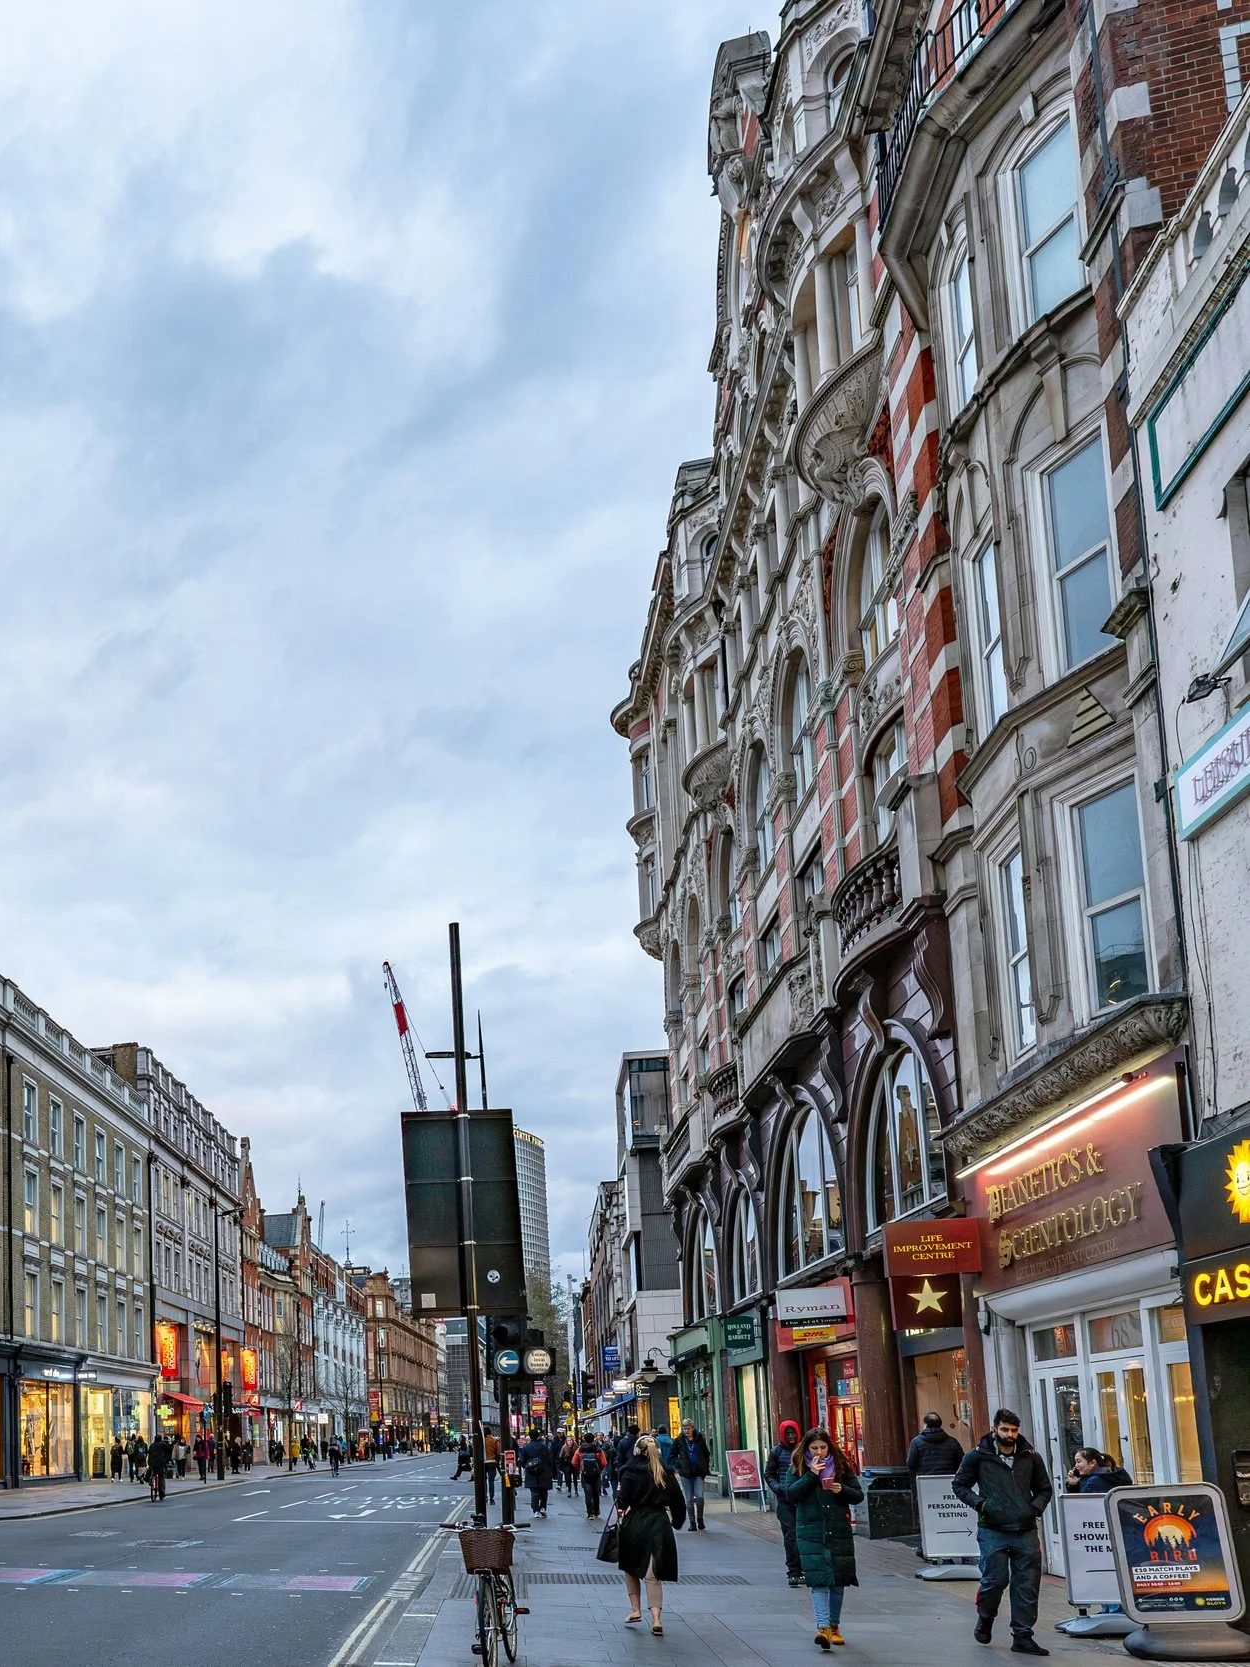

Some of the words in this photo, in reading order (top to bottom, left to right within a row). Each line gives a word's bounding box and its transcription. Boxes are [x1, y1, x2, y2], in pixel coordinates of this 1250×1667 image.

[985, 1147, 1083, 1224] DIANETICS
[1085, 1142, 1106, 1177] &
[999, 1182, 1142, 1269] SCIENTOLOGY
[921, 1234, 944, 1243] LIFE
[893, 1241, 973, 1253] IMPROVEMENT
[912, 1252, 956, 1261] CENTRE
[784, 1303, 841, 1314] Ryman
[727, 1323, 751, 1331] HOLLAND
[801, 1330, 826, 1338] DHL
[1133, 1502, 1201, 1524] EARLY
[1082, 1521, 1106, 1529] FREE
[1073, 1533, 1110, 1541] SHOWI
[1084, 1545, 1104, 1553] THE
[1150, 1548, 1198, 1563] BIRD
